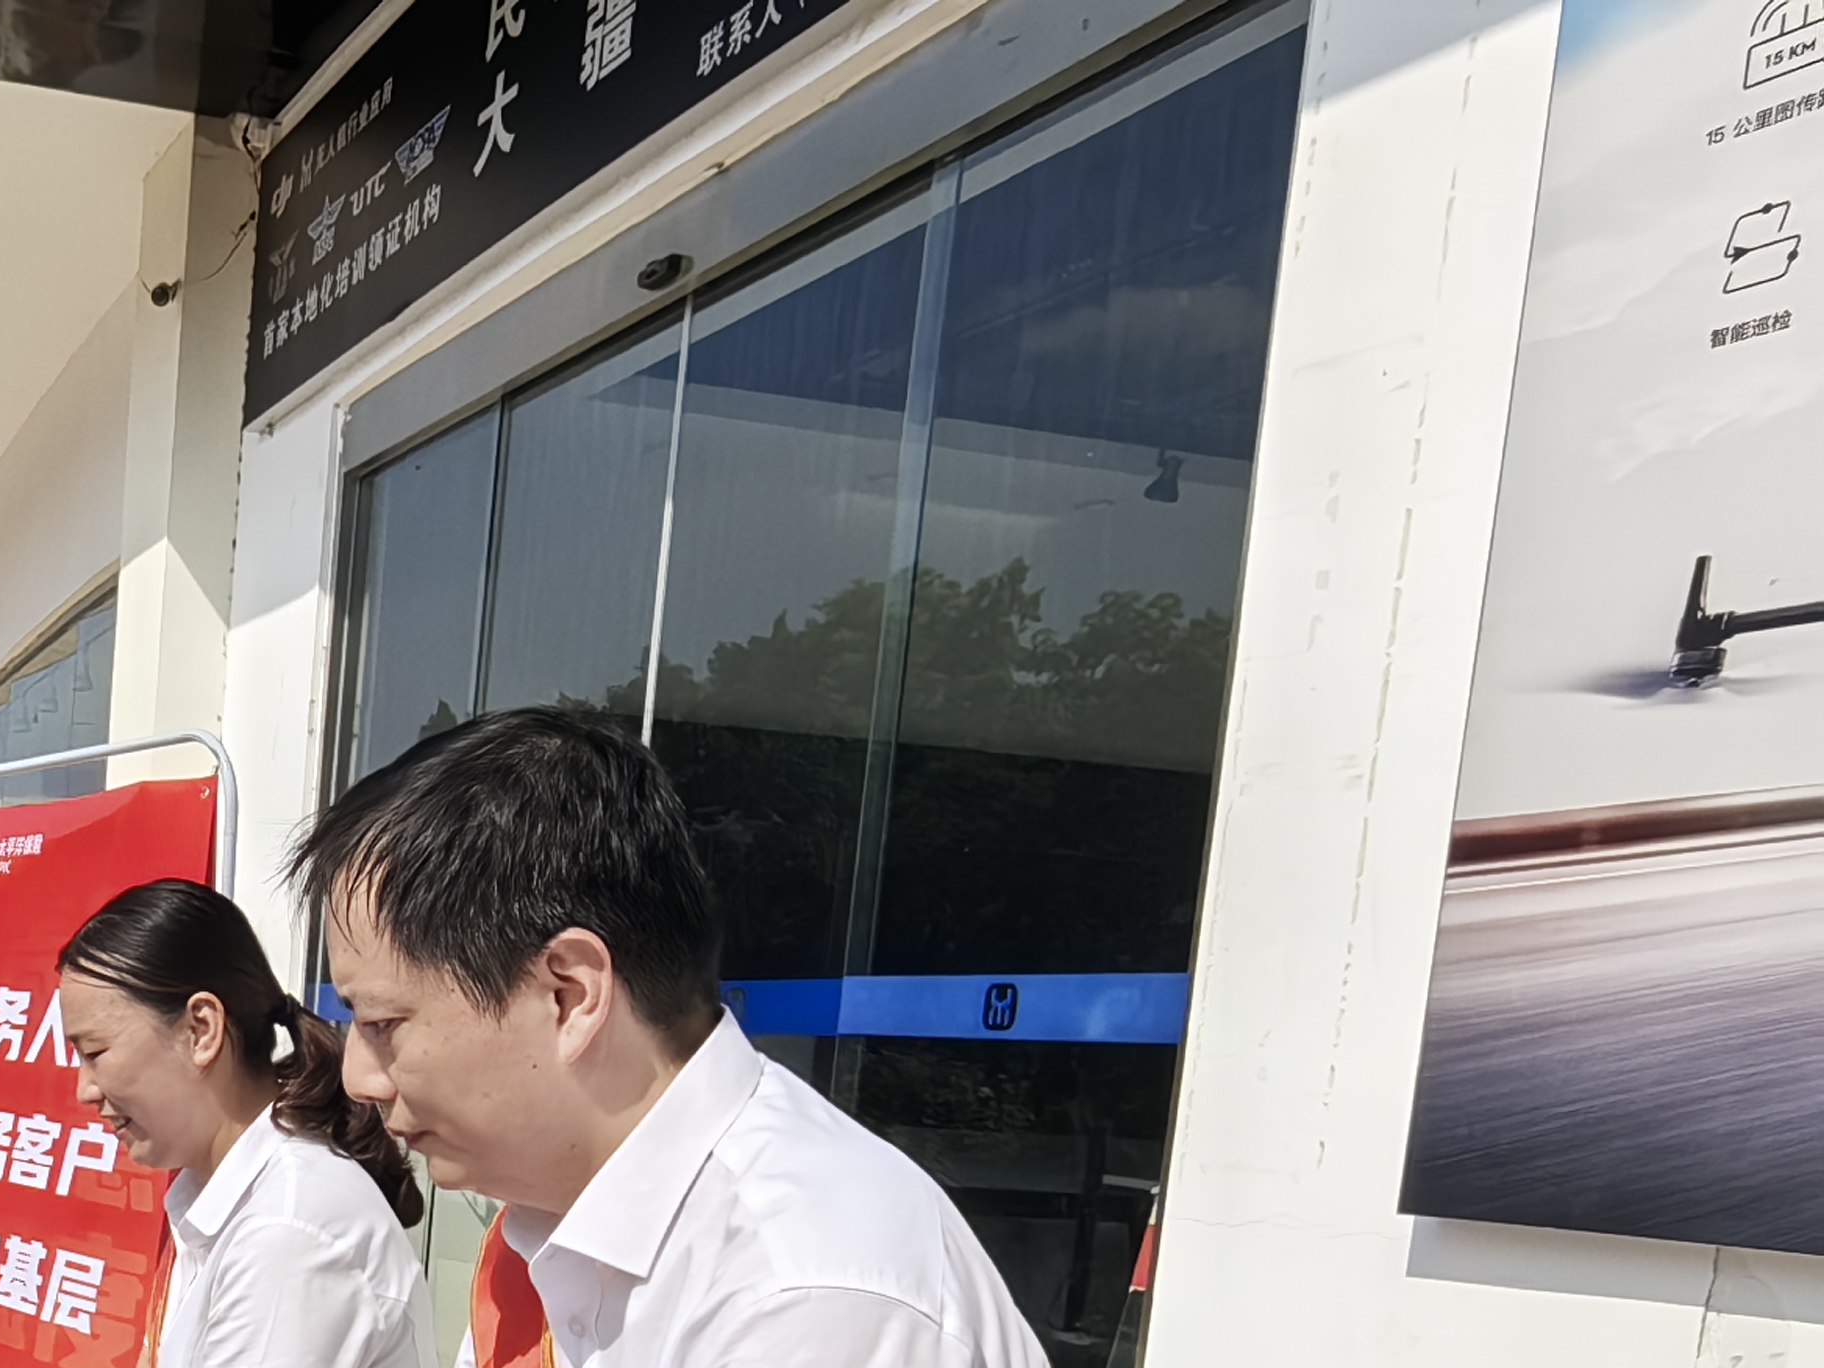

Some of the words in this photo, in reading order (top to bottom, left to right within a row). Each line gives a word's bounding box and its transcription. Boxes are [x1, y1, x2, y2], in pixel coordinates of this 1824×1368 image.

[1765, 49, 1784, 69] 15
[1788, 37, 1817, 60] KM
[1705, 125, 1726, 146] 15
[1710, 309, 1793, 350] 智能巡检
